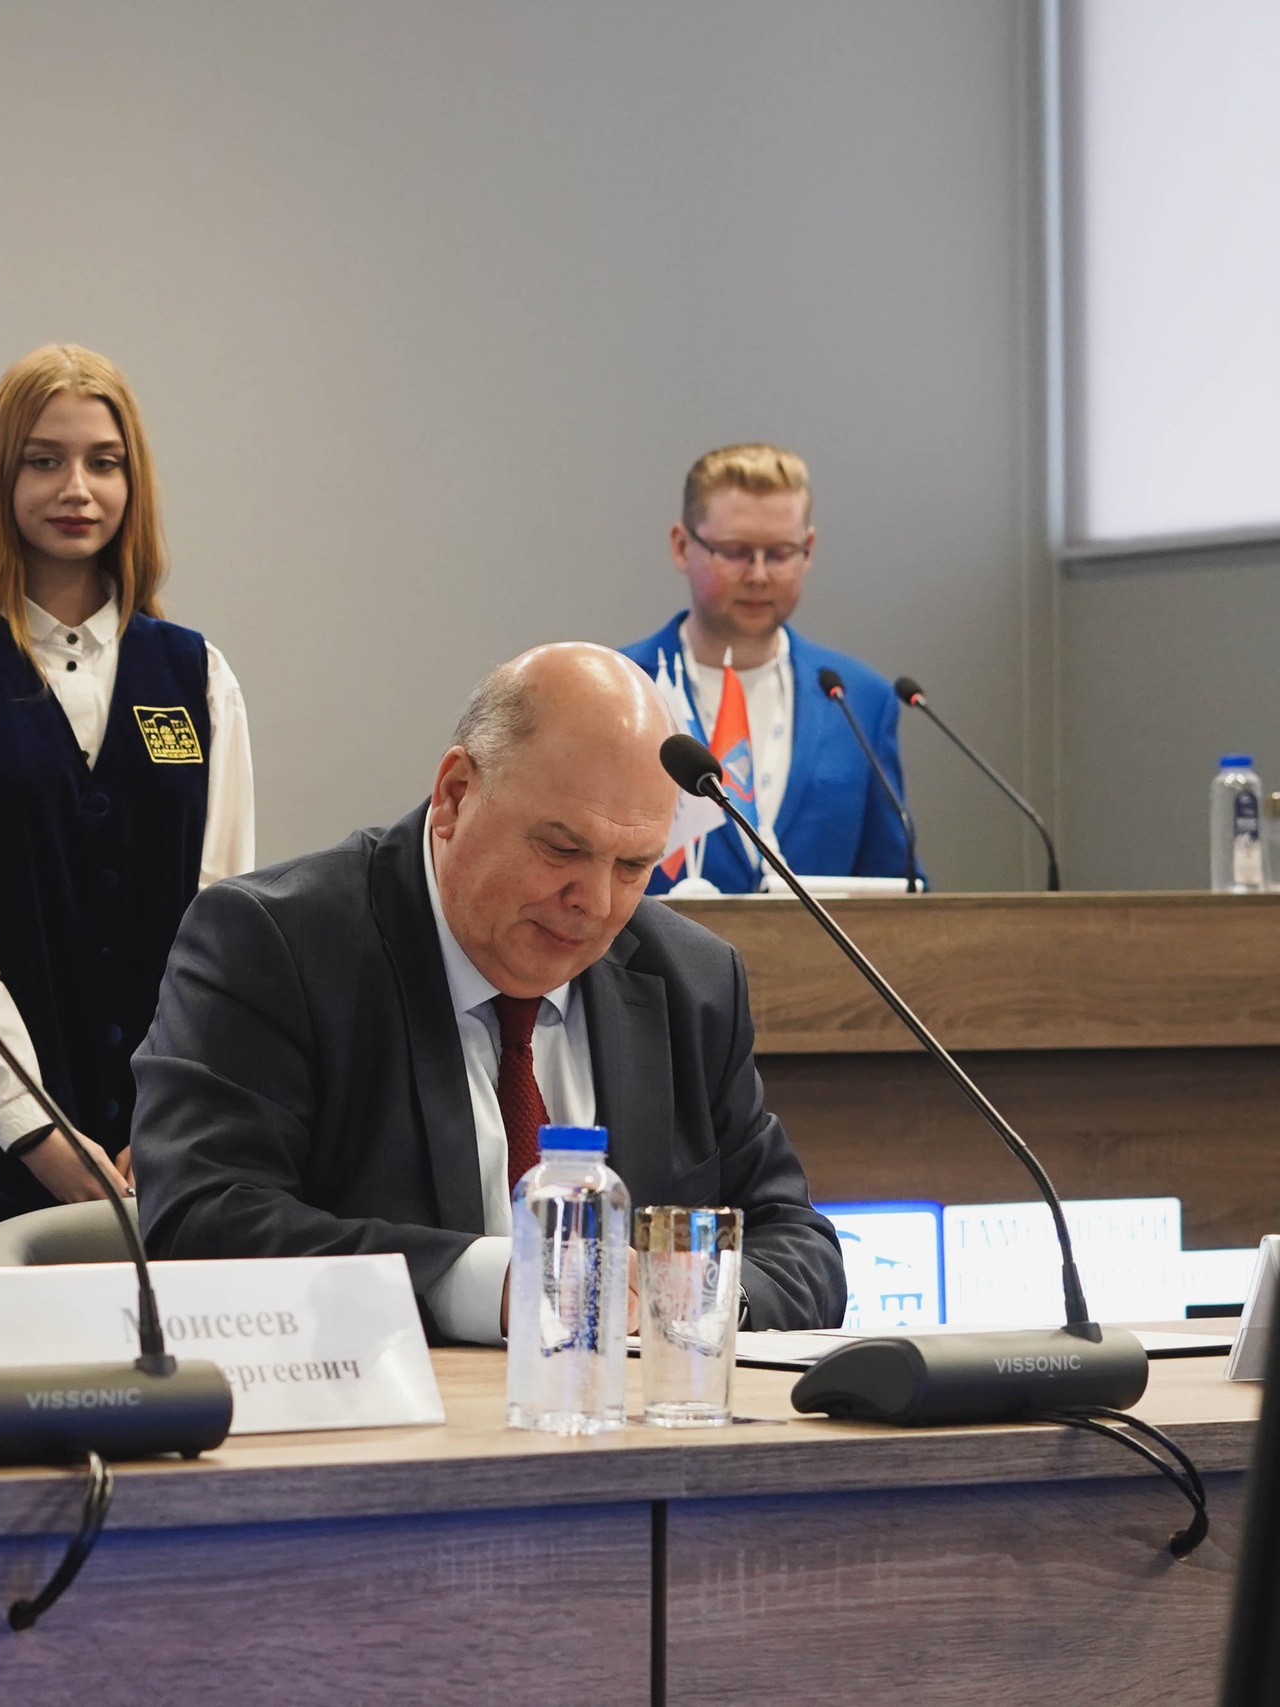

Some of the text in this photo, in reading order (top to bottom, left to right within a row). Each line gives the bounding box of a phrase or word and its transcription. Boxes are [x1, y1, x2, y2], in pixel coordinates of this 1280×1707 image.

[223, 1358, 362, 1392] ергеевич
[994, 1354, 1082, 1375] VISSONIC
[26, 1387, 141, 1411] VISSONIC
